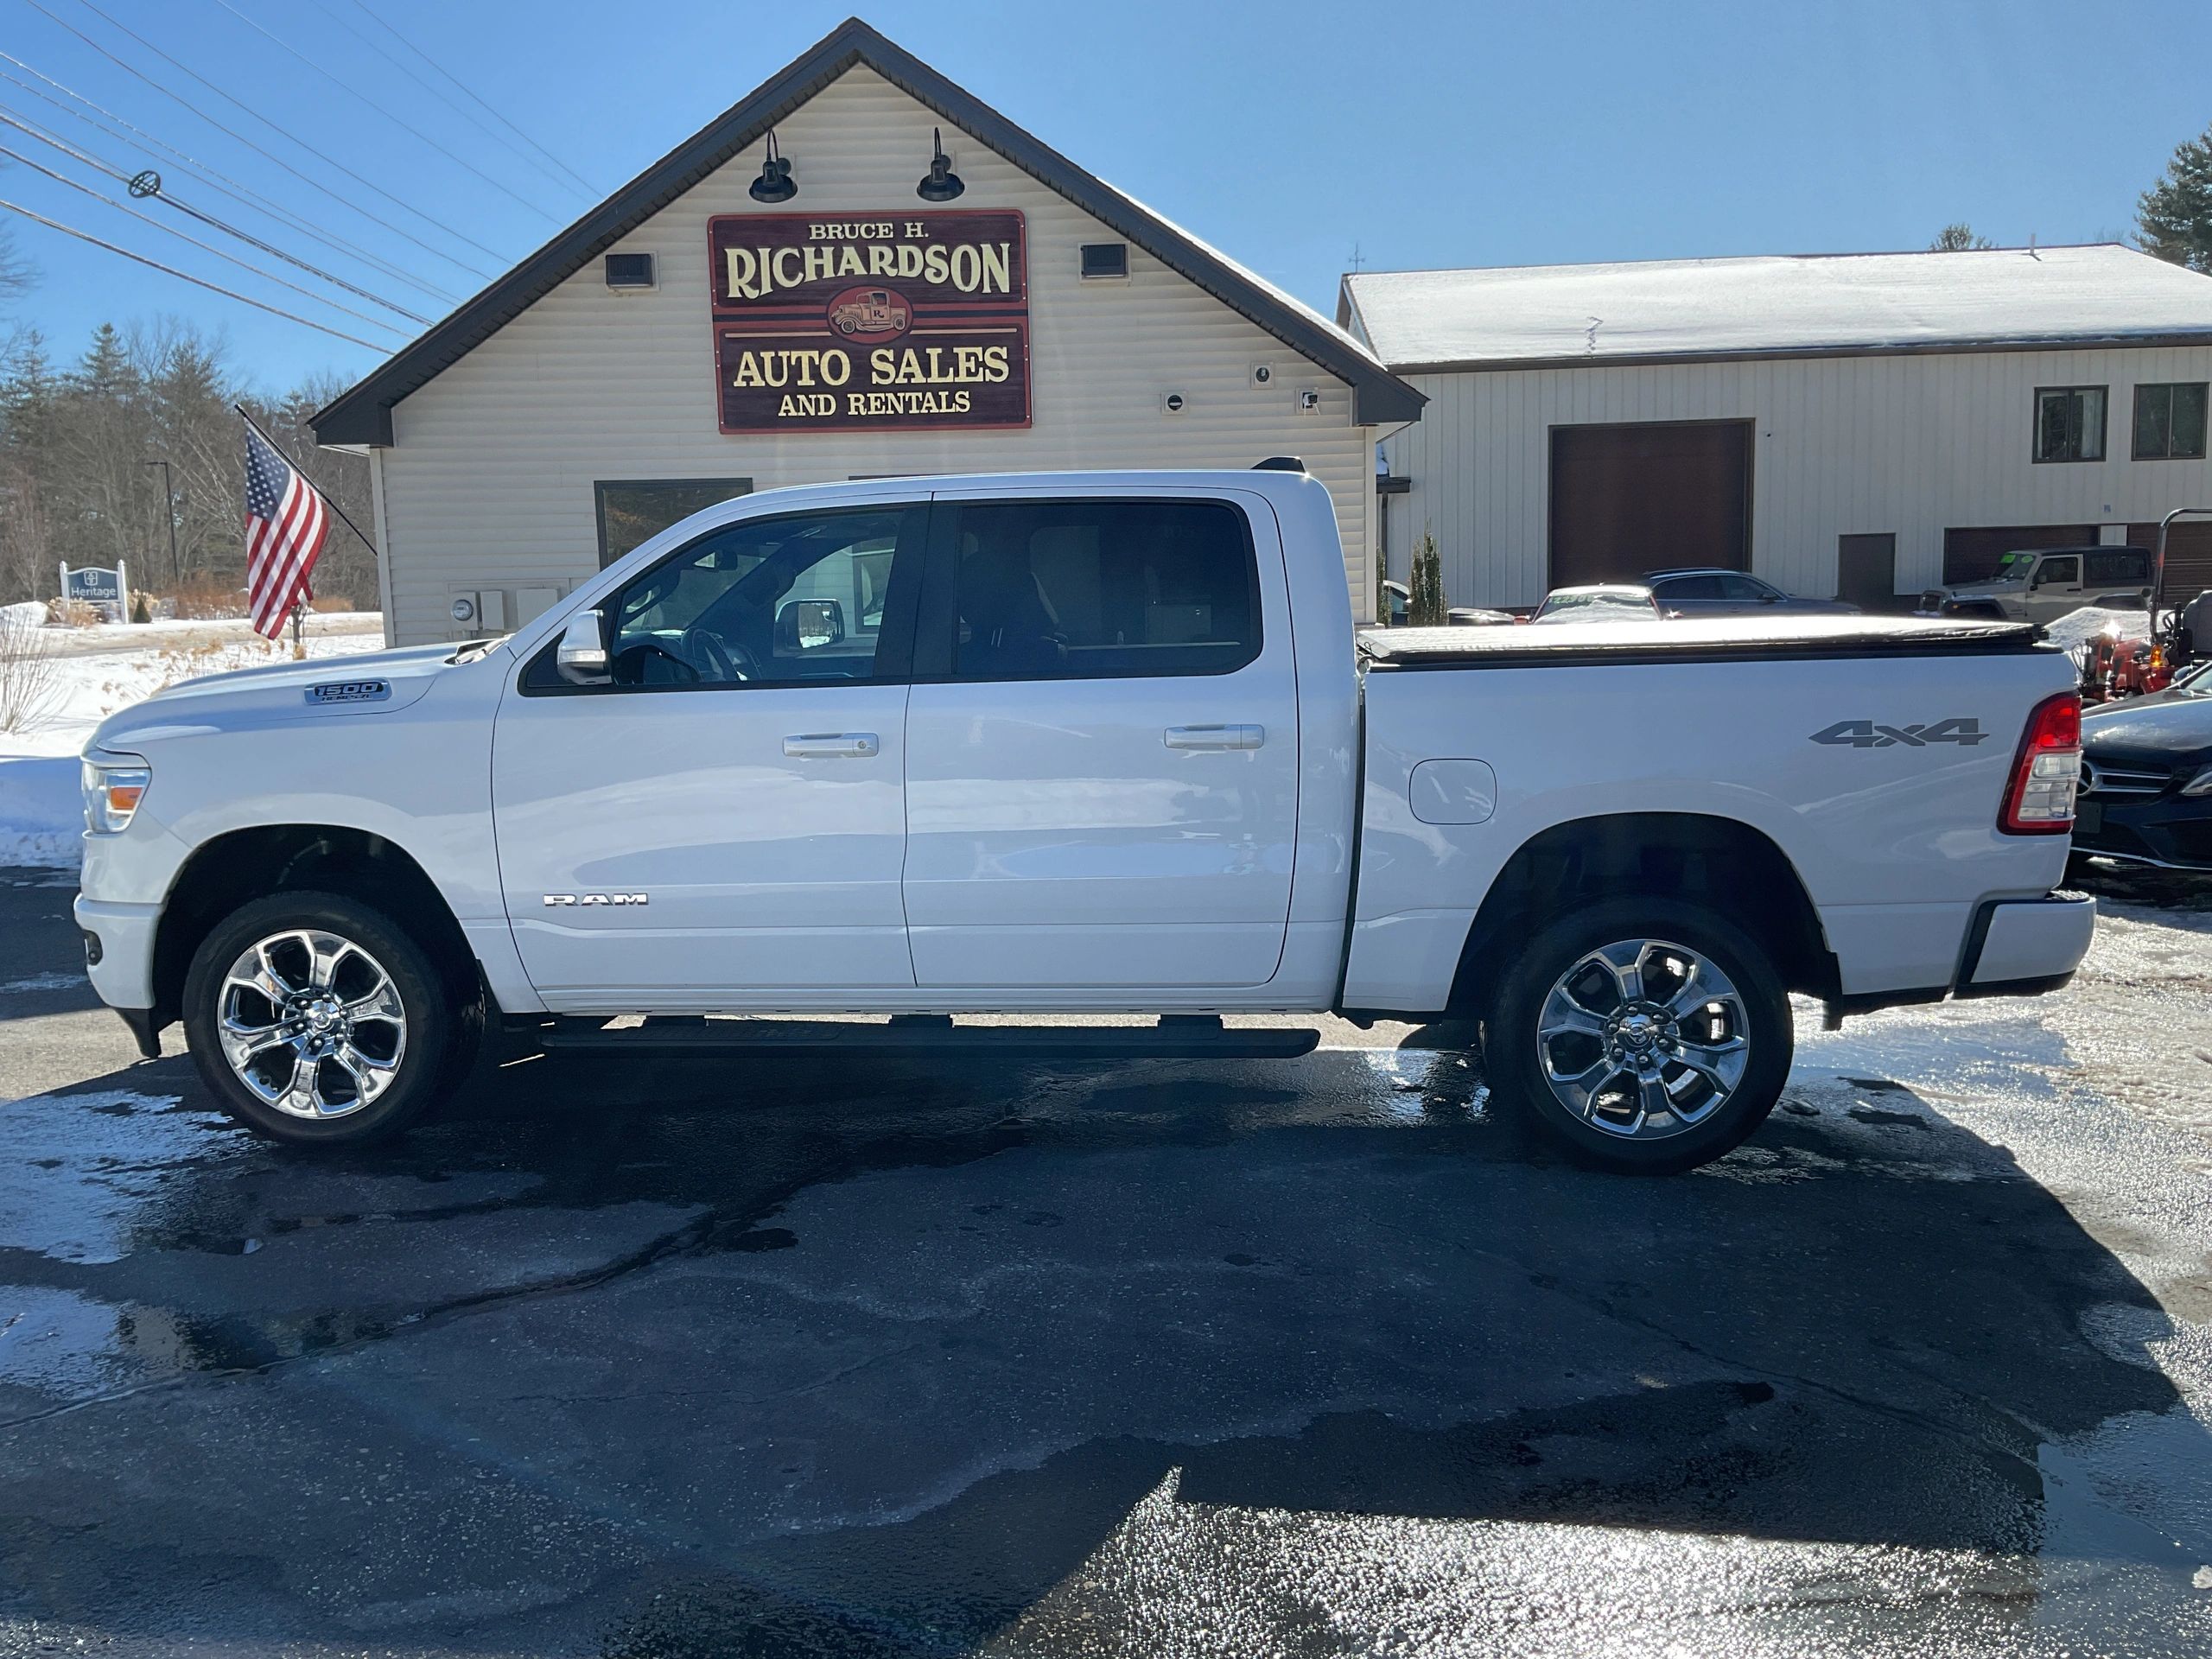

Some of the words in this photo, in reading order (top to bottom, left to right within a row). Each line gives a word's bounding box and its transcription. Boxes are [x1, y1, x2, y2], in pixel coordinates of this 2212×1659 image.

[809, 223, 893, 240] BRUCE
[904, 222, 929, 238] H.
[724, 243, 1011, 299] RICHARDSON
[734, 349, 851, 387] AUTO
[871, 346, 1009, 385] SALES
[778, 394, 837, 417] AND
[848, 391, 970, 416] RENTALS
[71, 587, 117, 598] Heritage
[316, 683, 378, 696] 1500
[543, 893, 649, 906] RAM
